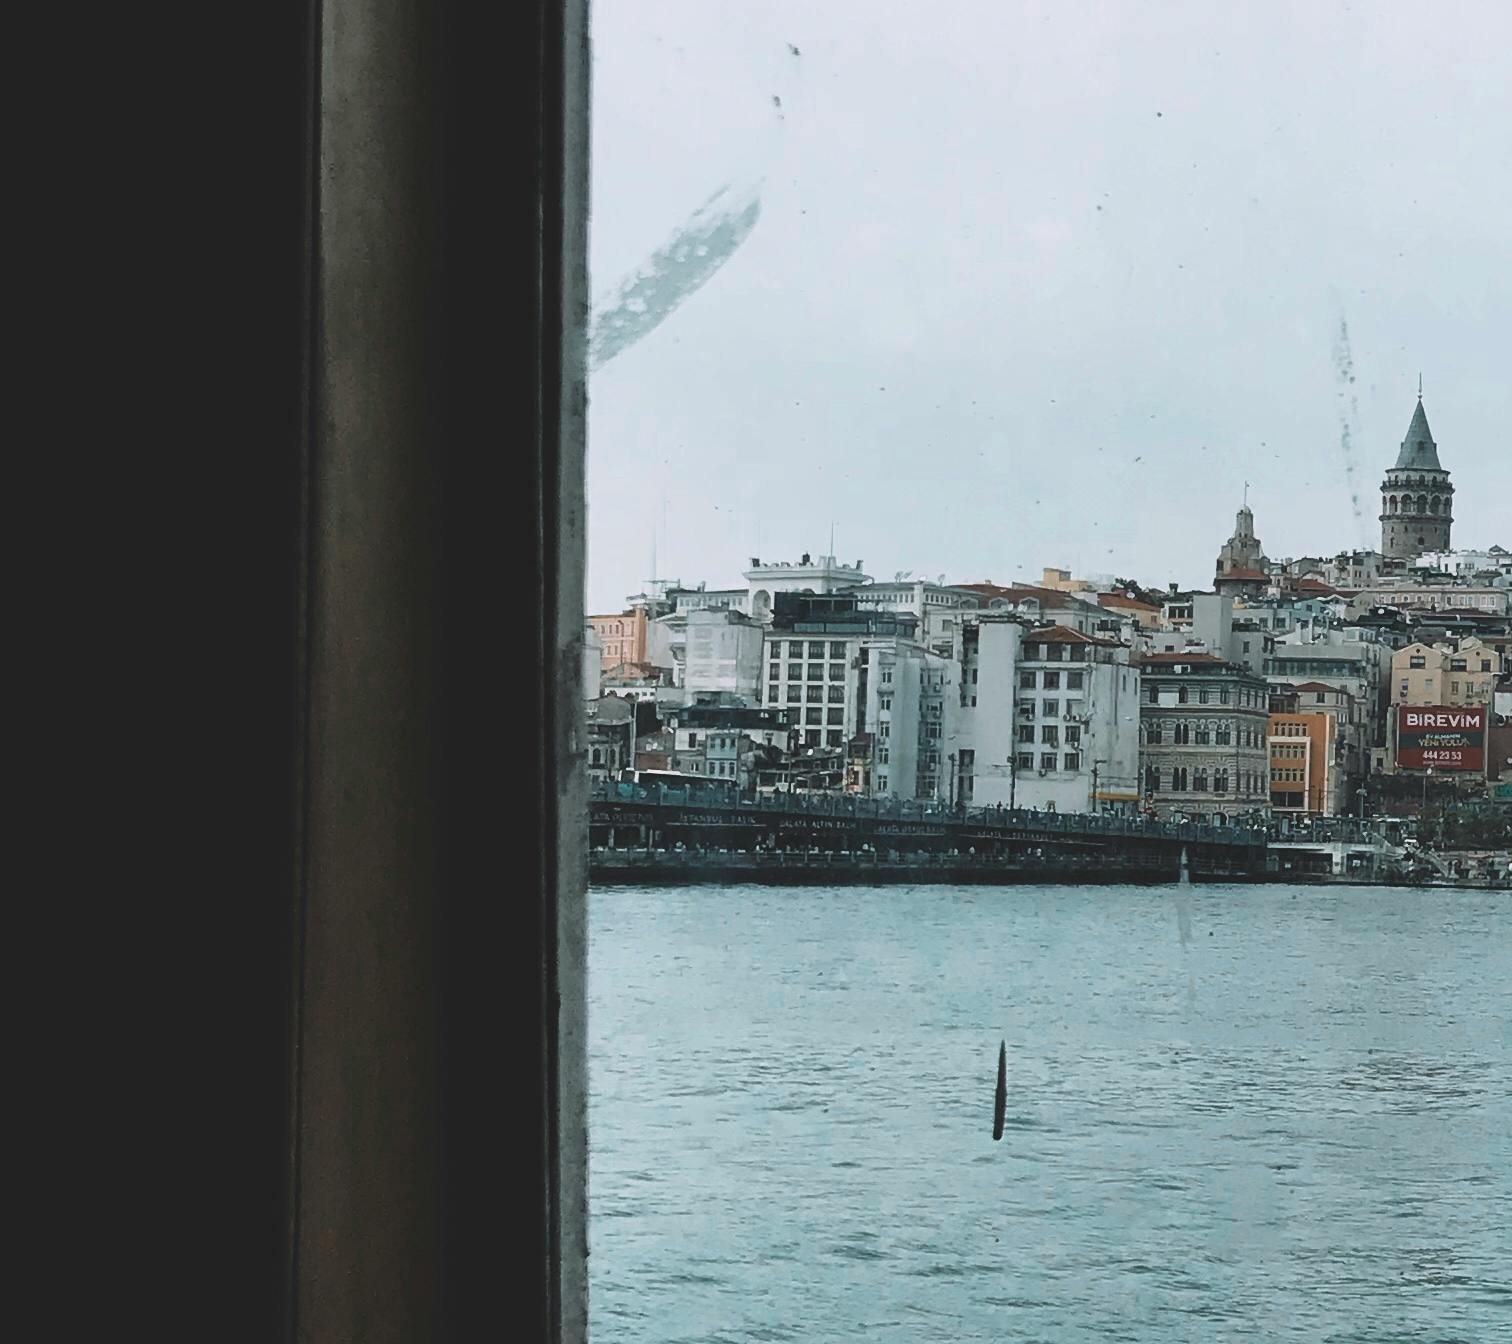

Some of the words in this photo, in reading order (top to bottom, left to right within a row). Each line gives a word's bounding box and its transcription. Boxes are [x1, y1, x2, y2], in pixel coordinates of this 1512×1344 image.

[1407, 714, 1480, 728] BİREVİM
[1423, 750, 1438, 759] 444
[1439, 751, 1450, 760] 23
[1451, 752, 1462, 760] 53
